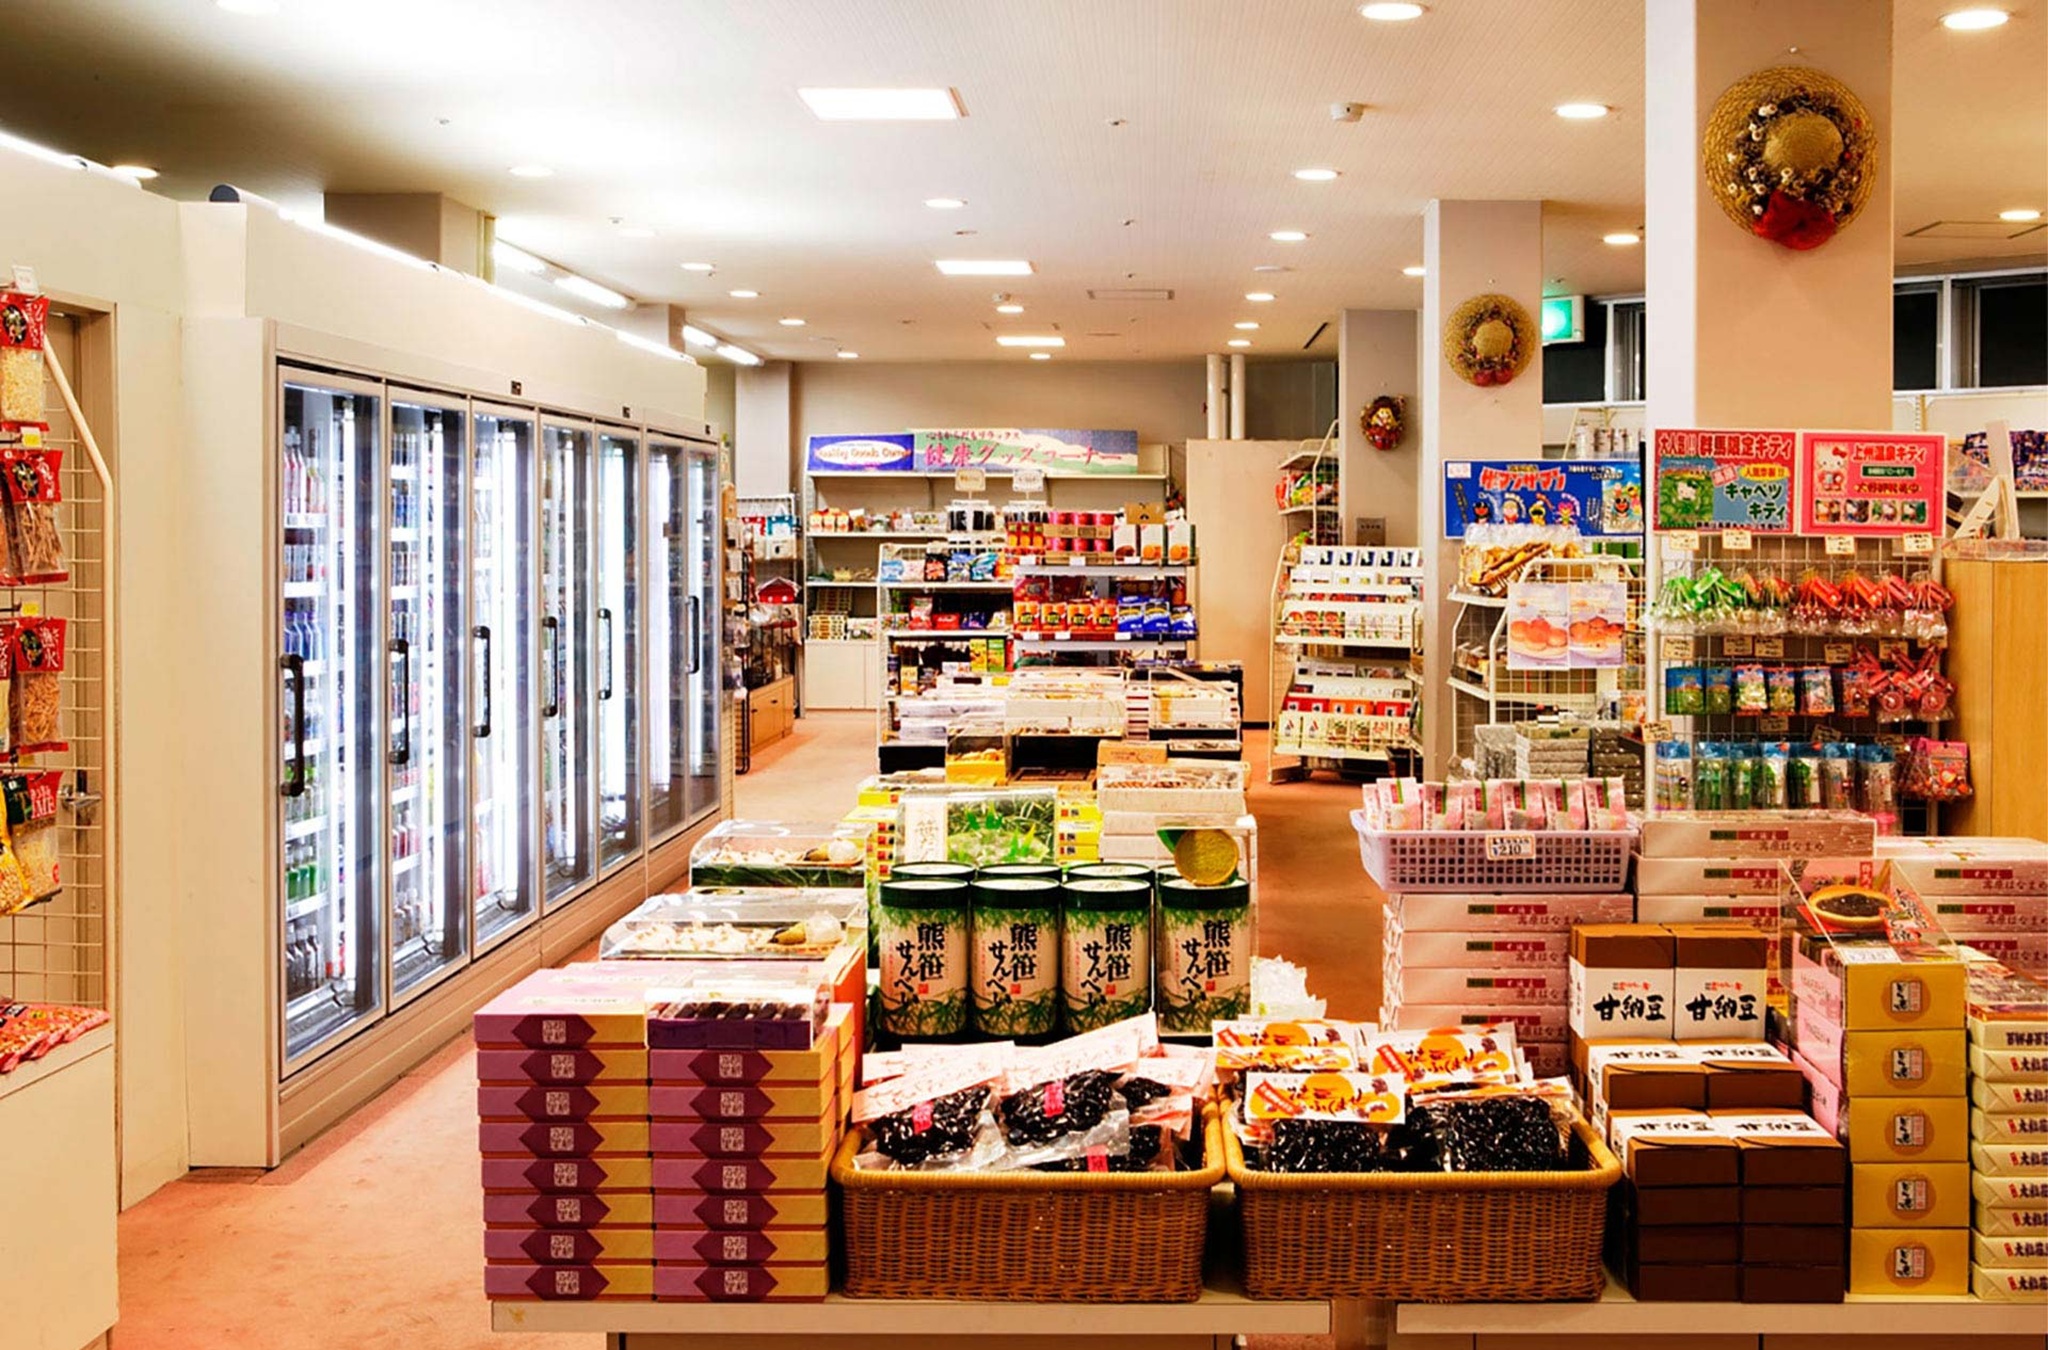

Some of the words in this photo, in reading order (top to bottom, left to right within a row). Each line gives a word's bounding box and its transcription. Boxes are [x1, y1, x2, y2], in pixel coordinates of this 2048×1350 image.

[925, 442, 1122, 467] 健康グッズコーナー
[1725, 482, 1783, 500] キャベツ
[1748, 502, 1787, 521] キティ
[894, 939, 920, 1005] せんべい
[917, 922, 945, 982] 熊笹
[985, 939, 1012, 1007] せんべい
[1009, 922, 1038, 982] 熊笹
[1081, 940, 1108, 1007] せんべい
[1103, 922, 1133, 983] 熊笹
[1181, 939, 1207, 1006] せんべい
[1203, 919, 1232, 981] 熊笹
[1593, 992, 1667, 1022] 甘納豆
[1686, 992, 1759, 1022] 甘納豆
